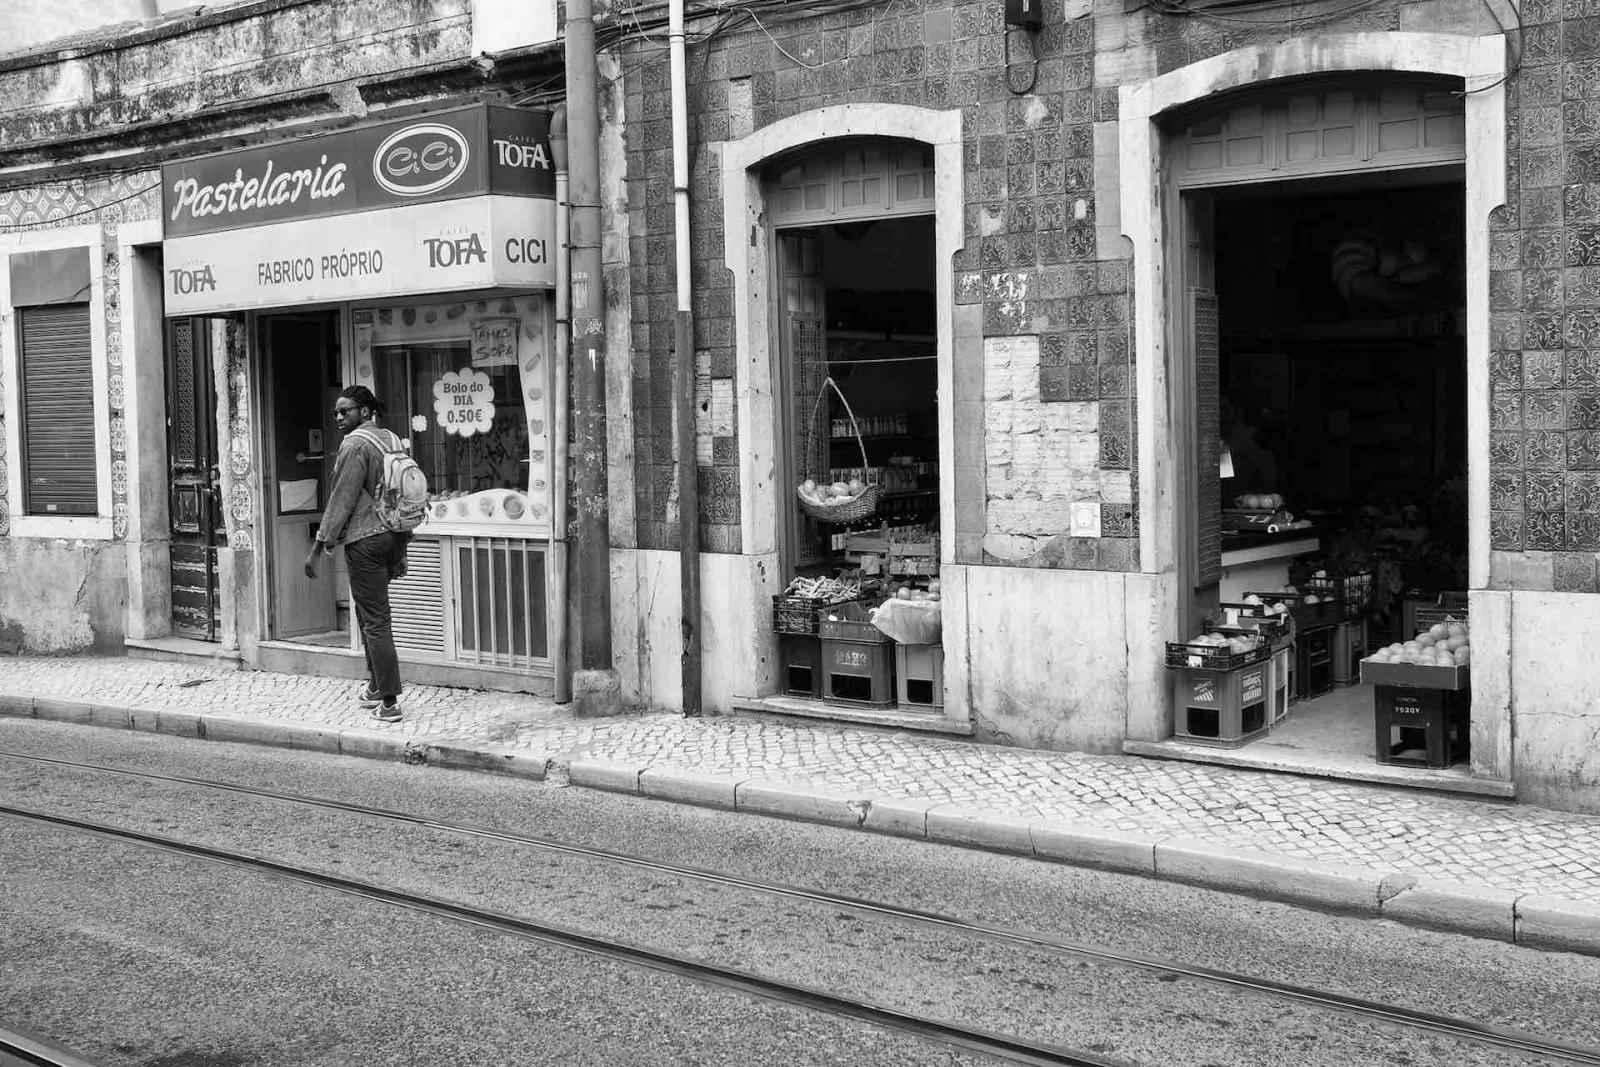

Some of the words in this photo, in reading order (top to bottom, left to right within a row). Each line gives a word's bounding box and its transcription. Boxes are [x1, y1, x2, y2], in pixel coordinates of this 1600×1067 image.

[493, 139, 550, 170] TOFA
[171, 154, 347, 221] Pastelaria
[423, 233, 487, 268] TOFA
[505, 238, 547, 264] CICI
[169, 265, 217, 295] TOFA
[258, 257, 314, 285] FABRICO
[321, 248, 383, 279] PRÓPRIO
[443, 382, 468, 393] Bolo
[470, 381, 484, 393] do
[453, 395, 474, 406] DIA
